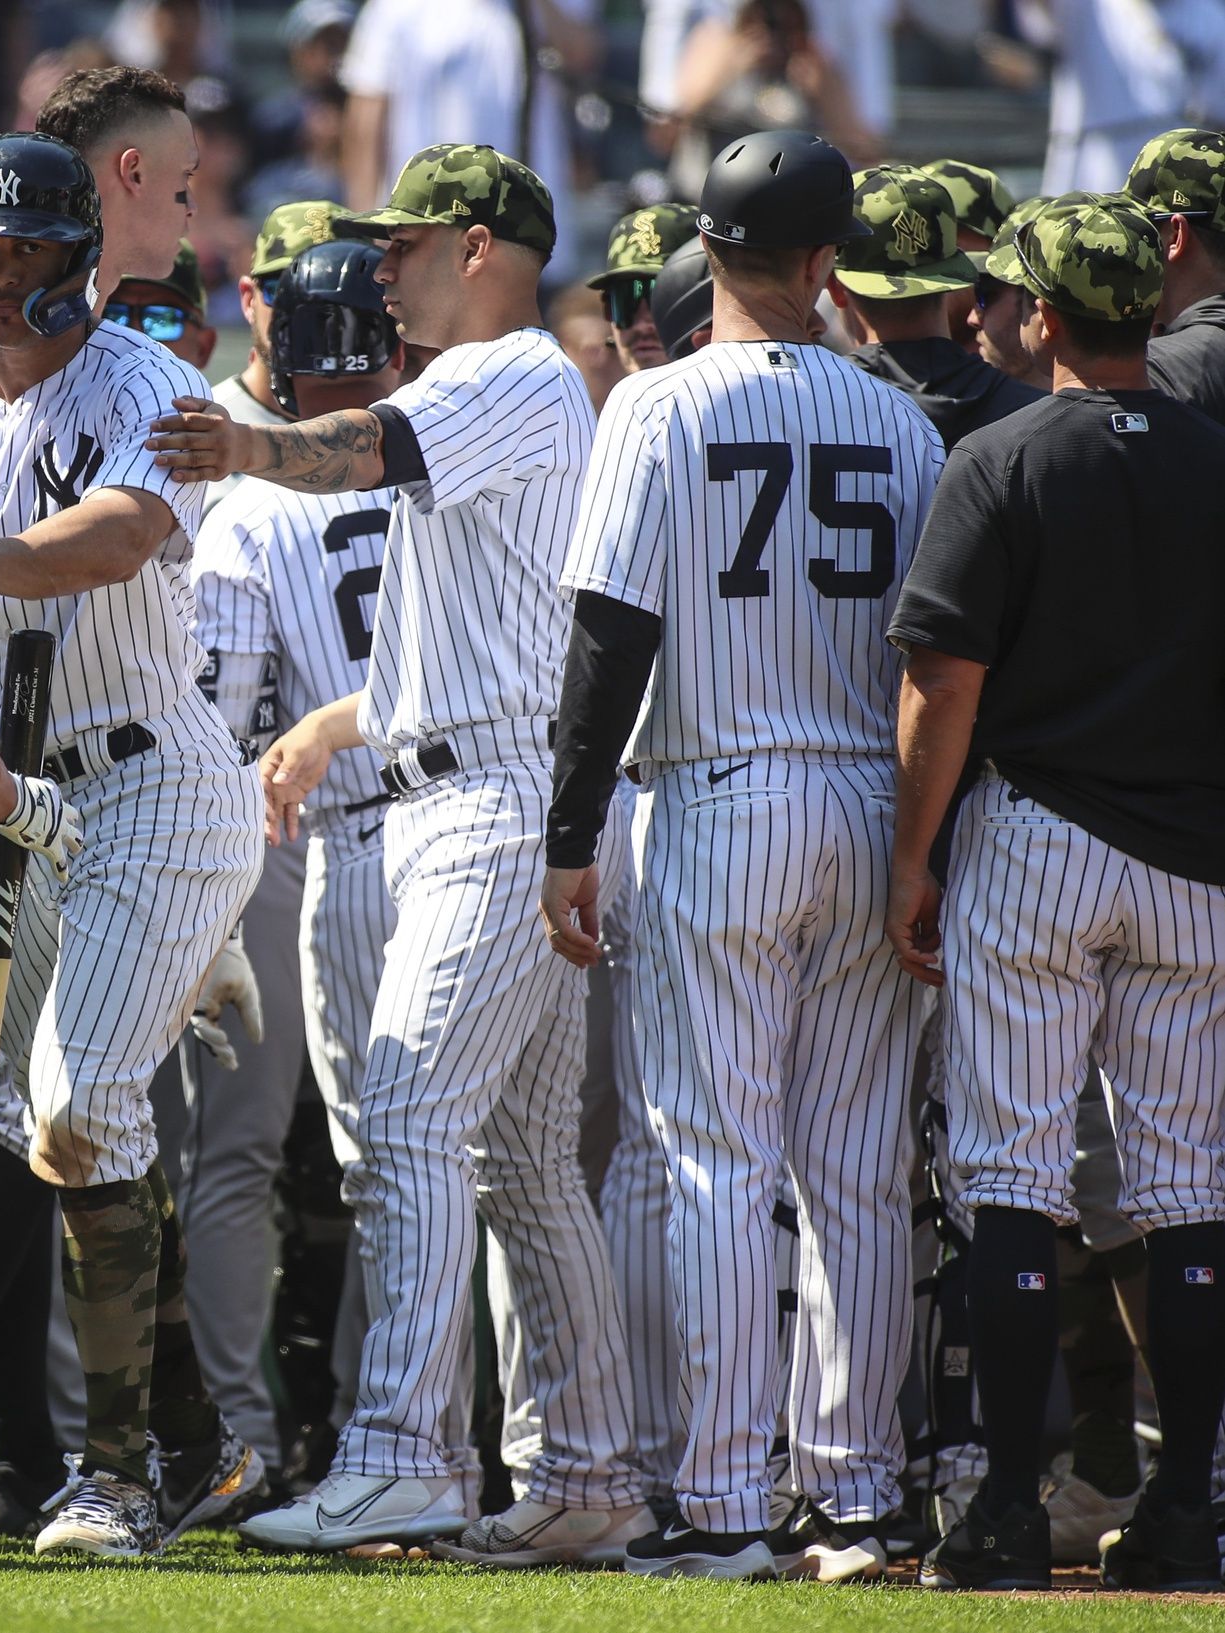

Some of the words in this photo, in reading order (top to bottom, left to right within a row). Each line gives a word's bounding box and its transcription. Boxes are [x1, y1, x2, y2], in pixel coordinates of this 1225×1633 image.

[891, 210, 928, 255] NY
[344, 354, 369, 371] 25
[32, 431, 104, 522] NY
[706, 442, 896, 599] 75
[259, 701, 275, 729] NY
[9, 879, 22, 937] marucci
[983, 1536, 996, 1549] 20
